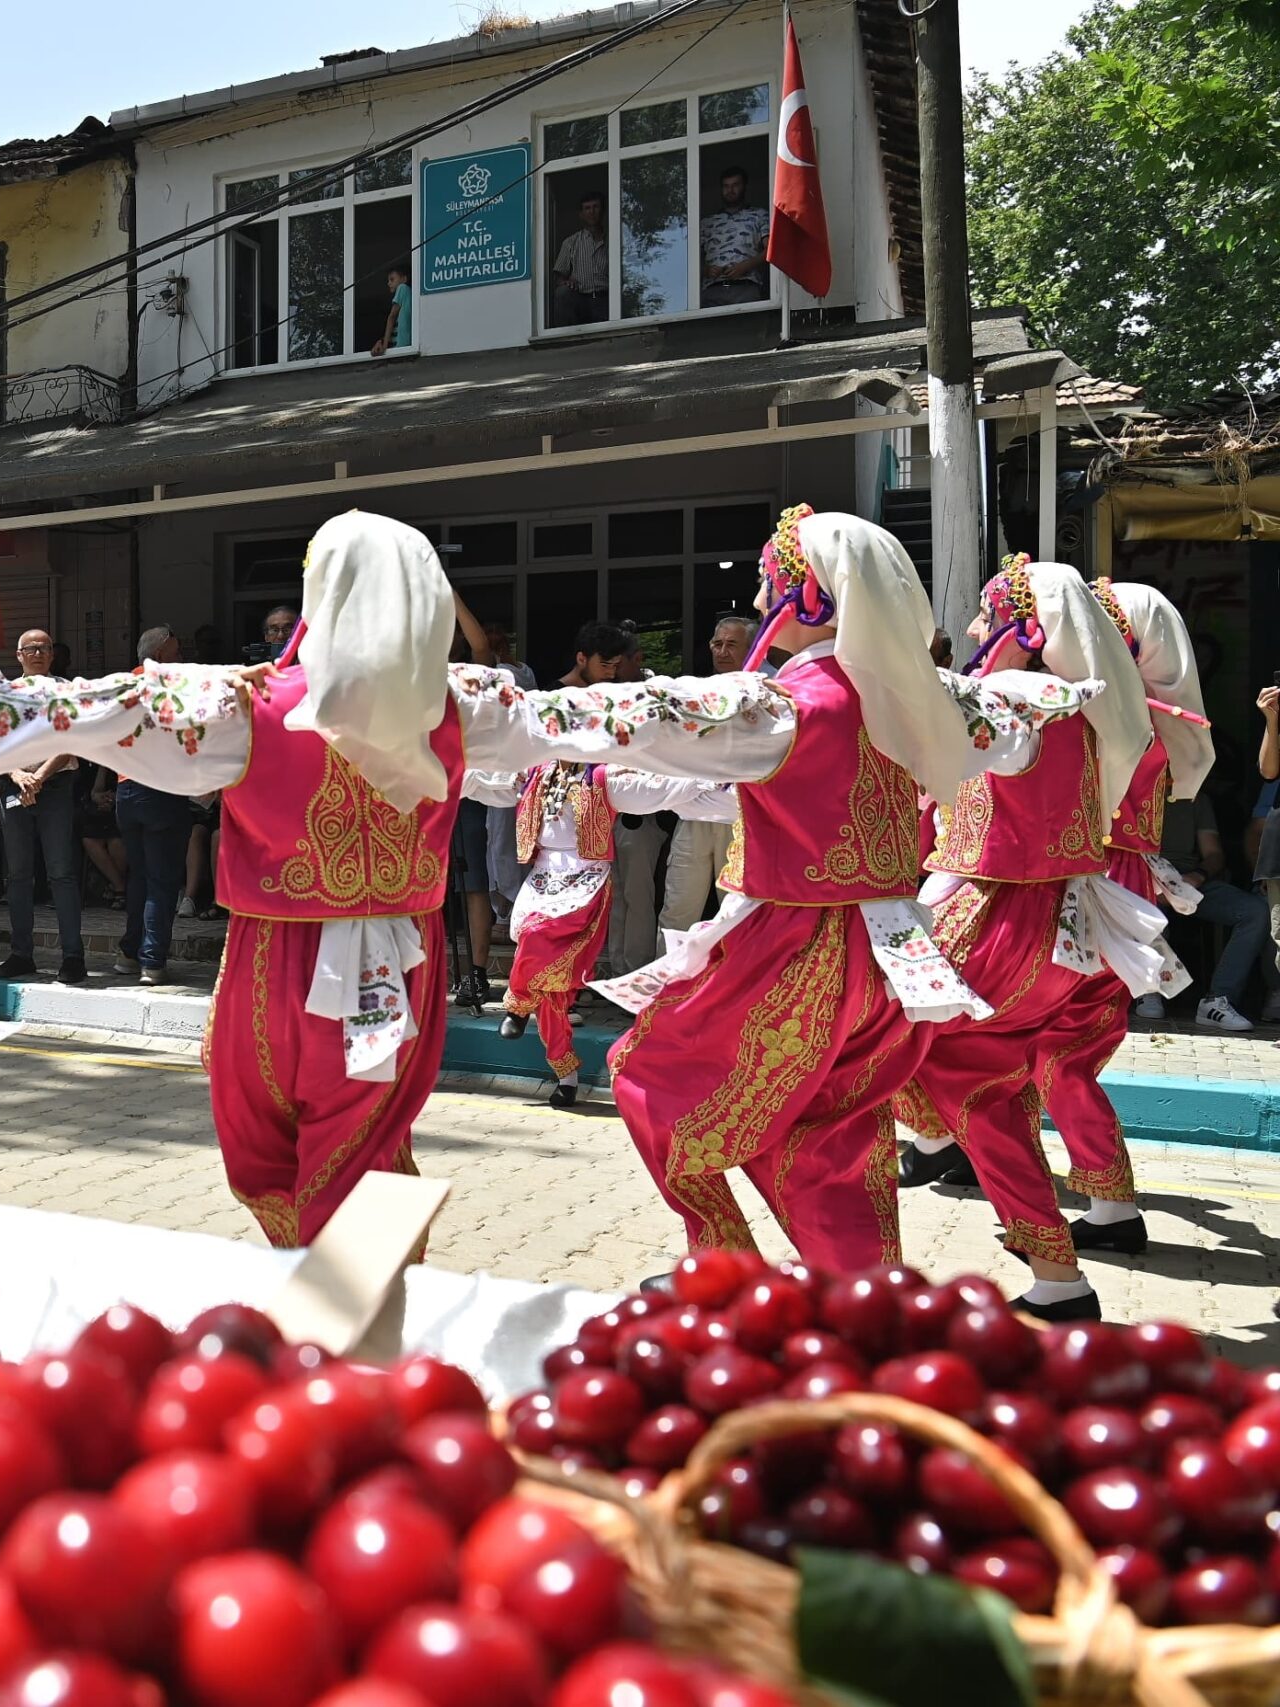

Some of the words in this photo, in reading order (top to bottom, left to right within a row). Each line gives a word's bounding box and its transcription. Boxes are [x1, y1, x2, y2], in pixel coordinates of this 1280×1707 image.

[463, 220, 487, 233] T.C.
[457, 232, 492, 250] NAİP
[434, 241, 516, 268] MAHALLESİ
[431, 257, 519, 283] MUHTARLIĞI
